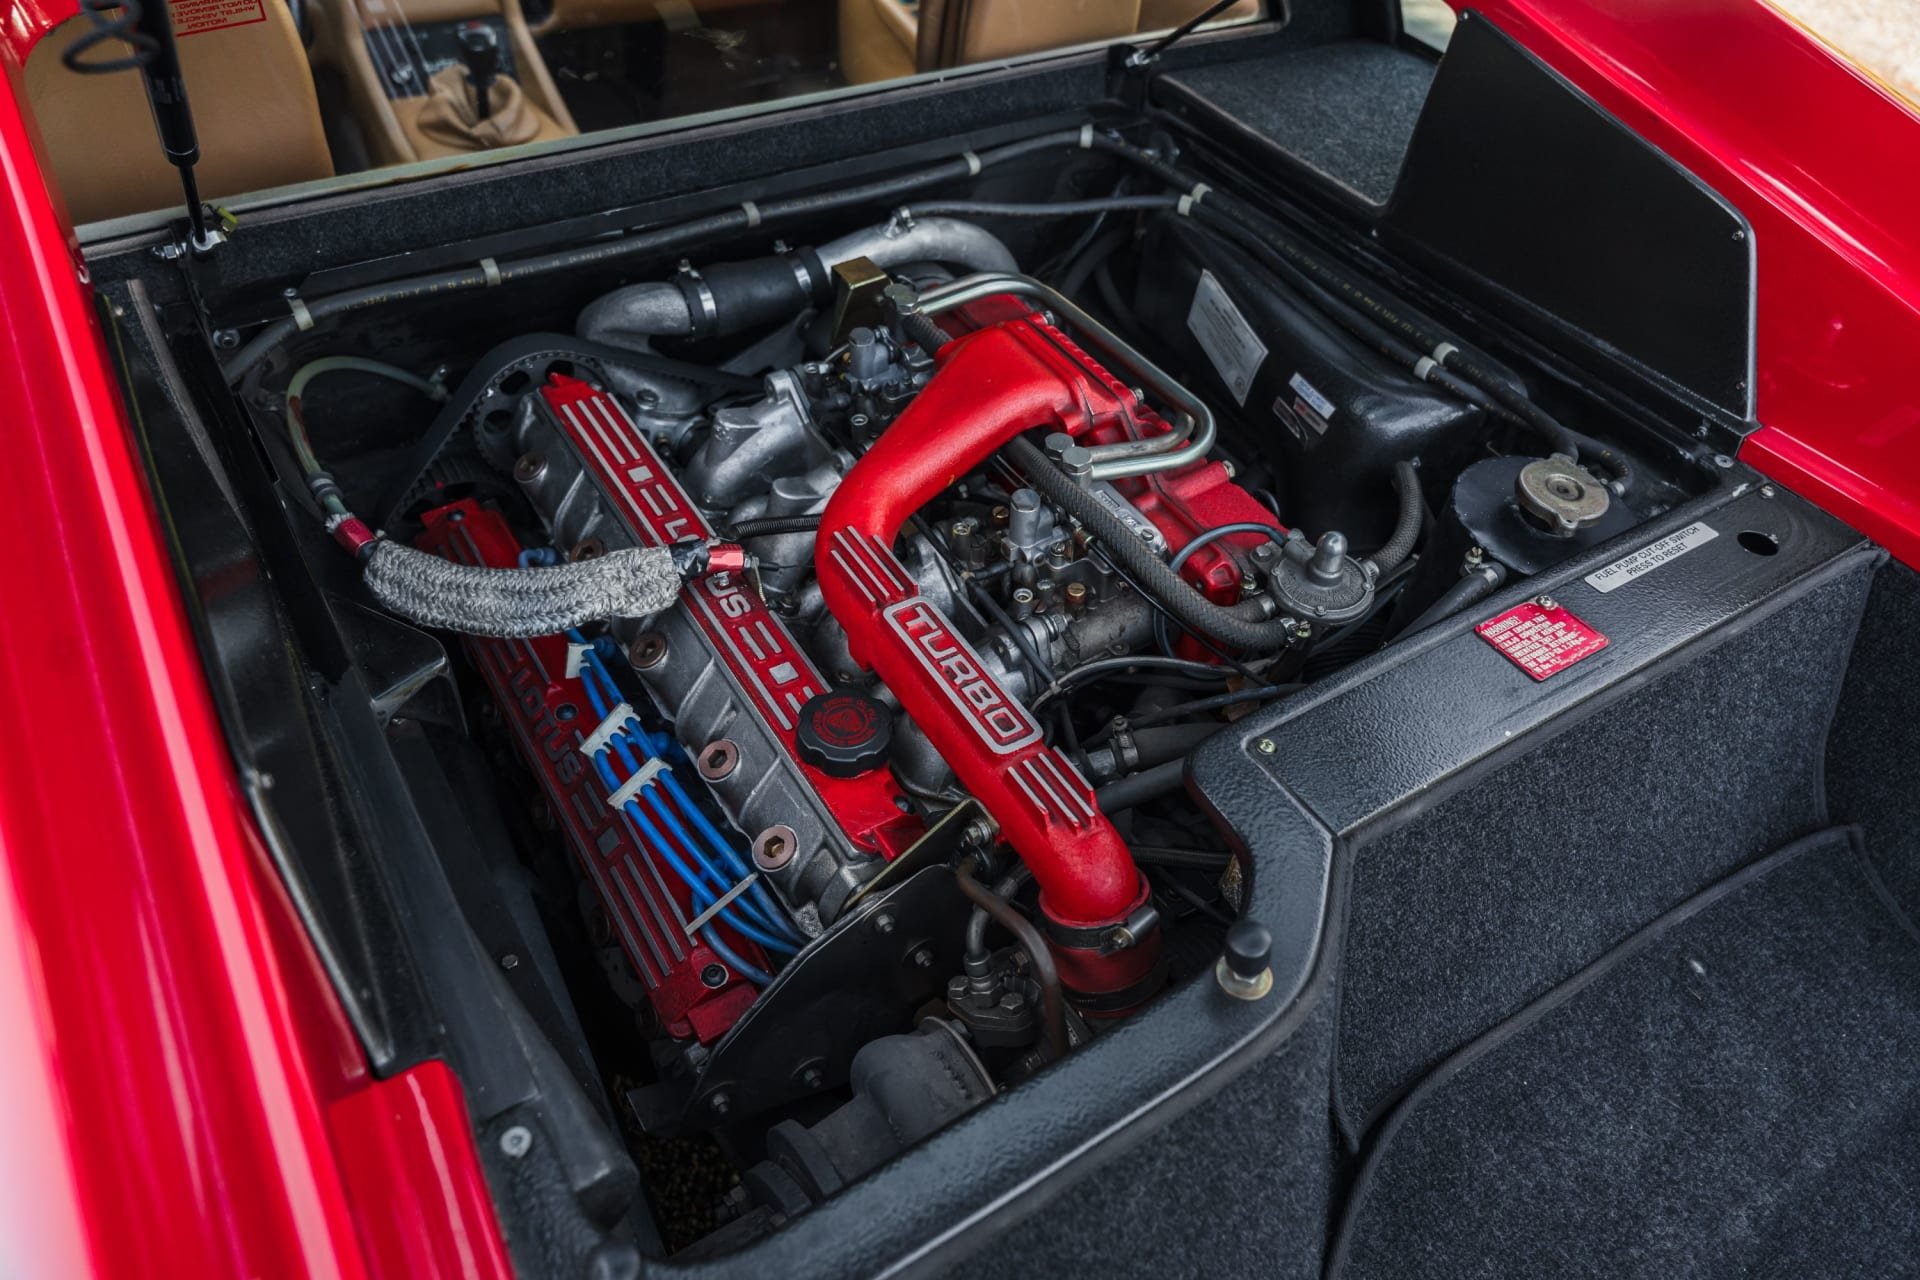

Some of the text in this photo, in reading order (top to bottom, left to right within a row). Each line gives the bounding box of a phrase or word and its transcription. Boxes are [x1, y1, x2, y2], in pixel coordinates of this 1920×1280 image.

[1594, 526, 1700, 581] FUEL PUMP CUT-OFF SWITCH
[1626, 542, 1689, 576] PRESS TO RESET
[904, 606, 1025, 738] TURBO
[511, 668, 582, 785] LOTUS
